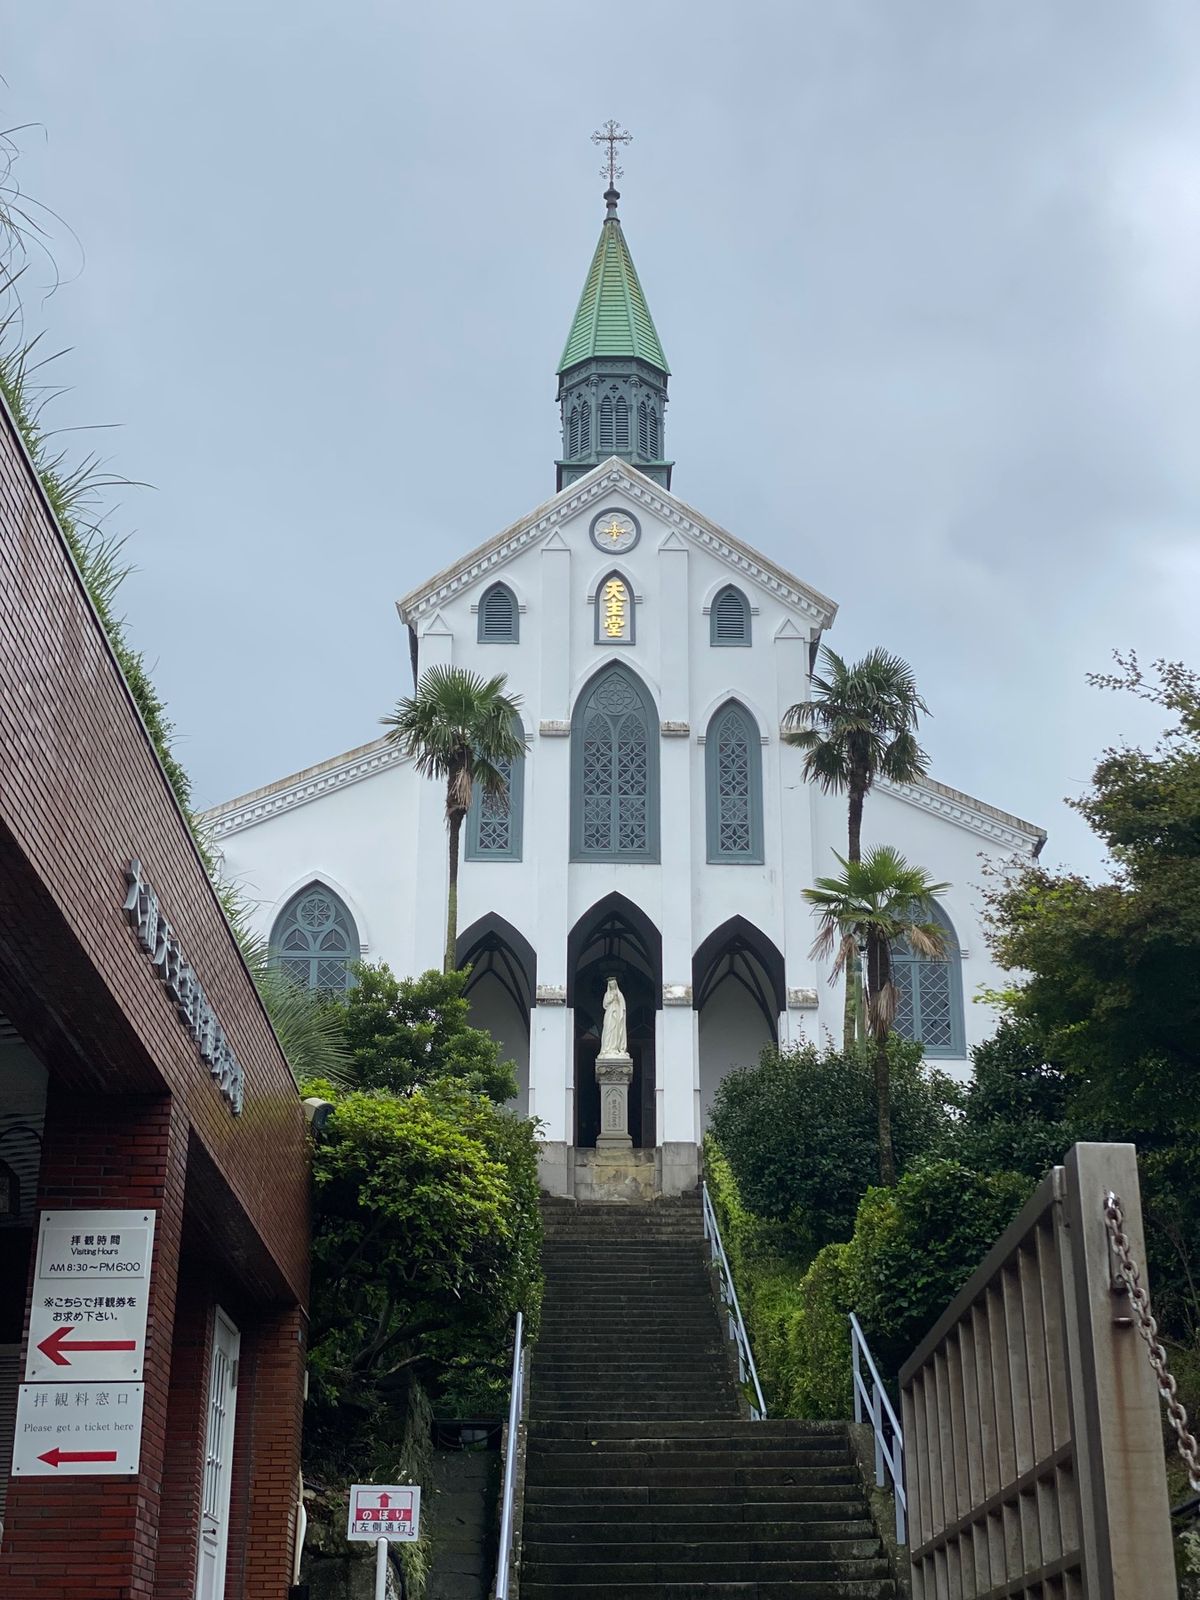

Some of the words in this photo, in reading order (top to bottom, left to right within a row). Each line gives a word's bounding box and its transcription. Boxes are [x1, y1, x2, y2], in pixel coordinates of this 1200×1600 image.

[603, 580, 627, 637] 天主堂
[71, 1235, 121, 1246] 拝観時間
[71, 1248, 97, 1256] Visiting
[34, 1392, 129, 1407] 拝観料窓口
[24, 1423, 52, 1432] Please
[56, 1424, 71, 1433] get
[84, 1421, 110, 1431] ticket
[114, 1421, 134, 1431] here
[362, 1510, 404, 1520] のぼり
[360, 1522, 407, 1532] 左側通行
